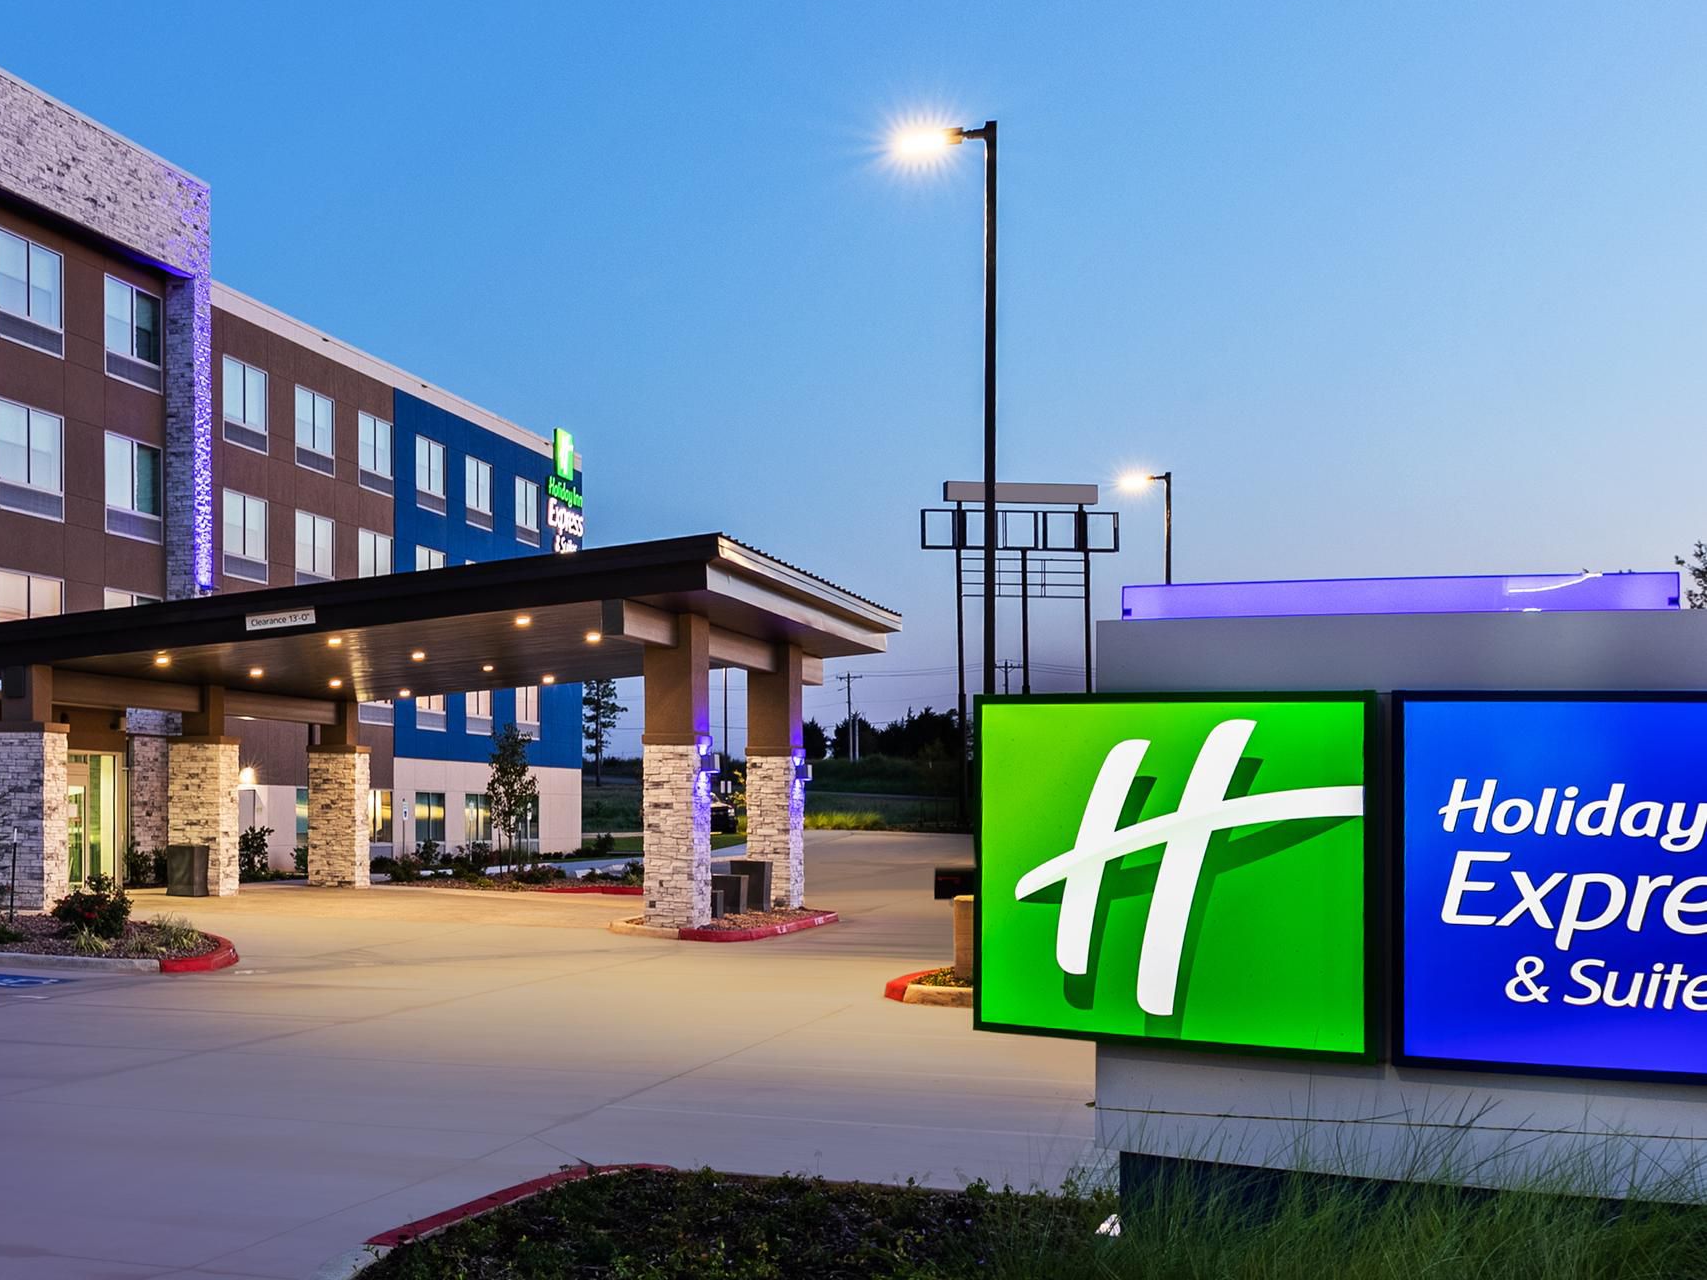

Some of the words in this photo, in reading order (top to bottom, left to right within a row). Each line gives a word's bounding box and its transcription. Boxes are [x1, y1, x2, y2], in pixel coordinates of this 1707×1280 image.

[548, 475, 574, 508] Holiday
[547, 497, 584, 538] Express
[250, 616, 287, 627] Clearance
[1438, 778, 1707, 853] Holiday
[1014, 718, 1365, 1017] H
[1504, 955, 1550, 1003] &
